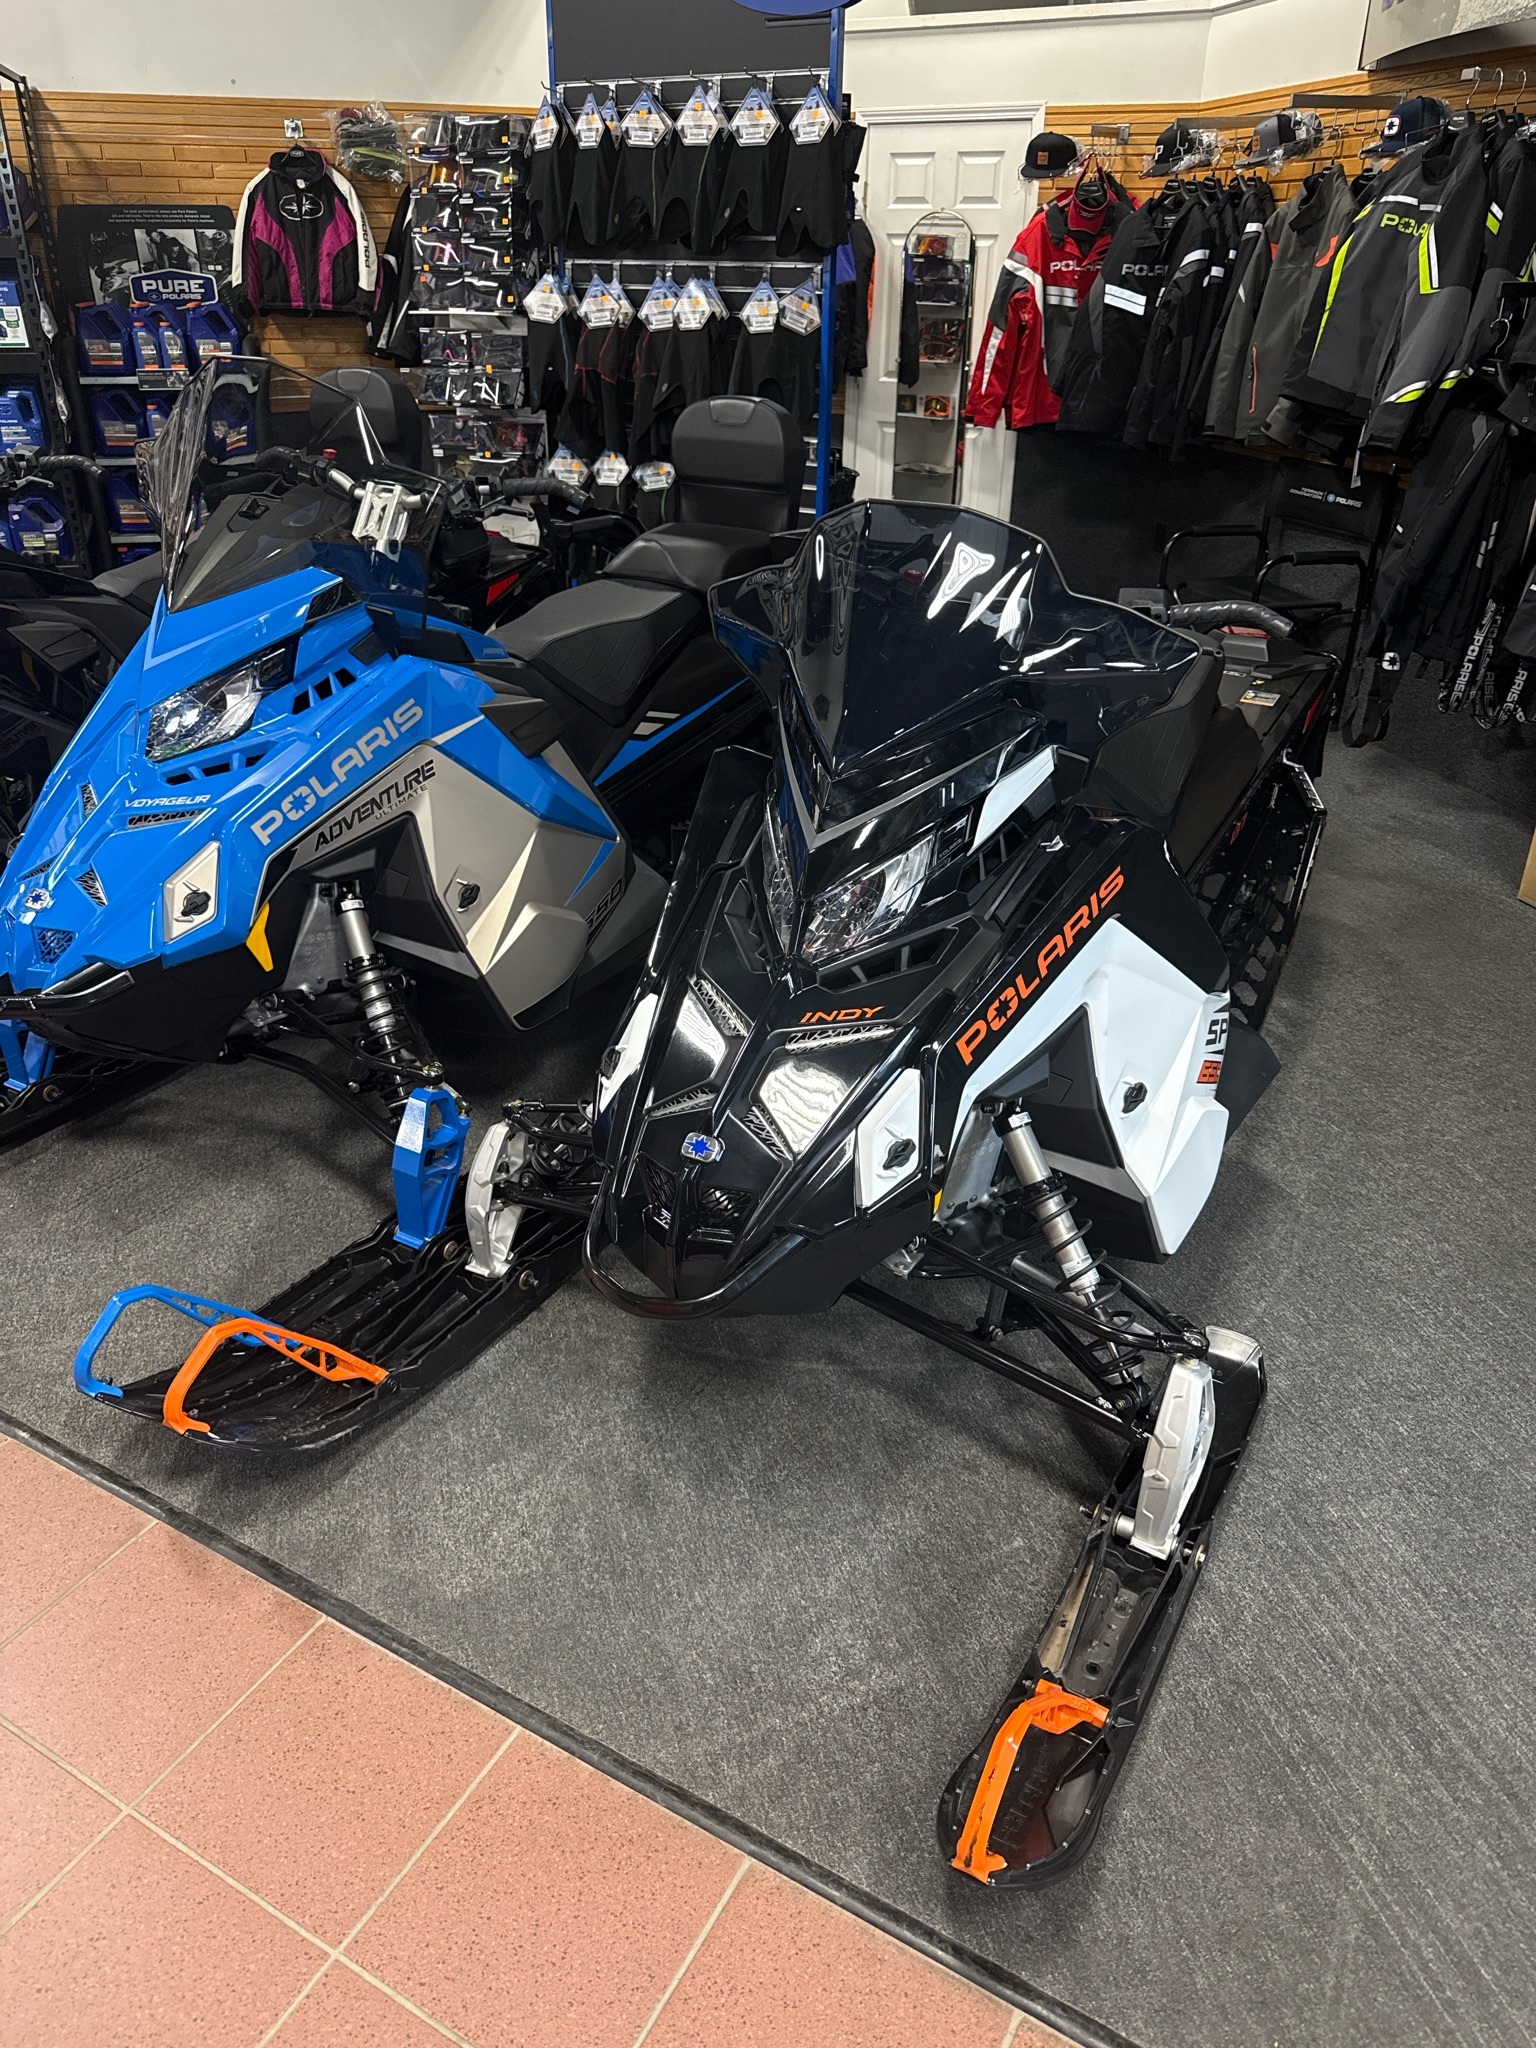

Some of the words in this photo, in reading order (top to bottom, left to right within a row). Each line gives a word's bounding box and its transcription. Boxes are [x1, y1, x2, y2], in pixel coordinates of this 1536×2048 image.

[141, 279, 205, 293] PURE
[1335, 496, 1363, 508] POLARIS
[1454, 635, 1484, 697] POLARIS
[250, 697, 424, 847] POLARIS
[124, 794, 212, 808] VOYAGEUR
[313, 758, 437, 853] ADVENTURE
[374, 783, 429, 821] ULTIMATE
[955, 865, 1125, 1066] POLARIS
[799, 1005, 886, 1025] INDY
